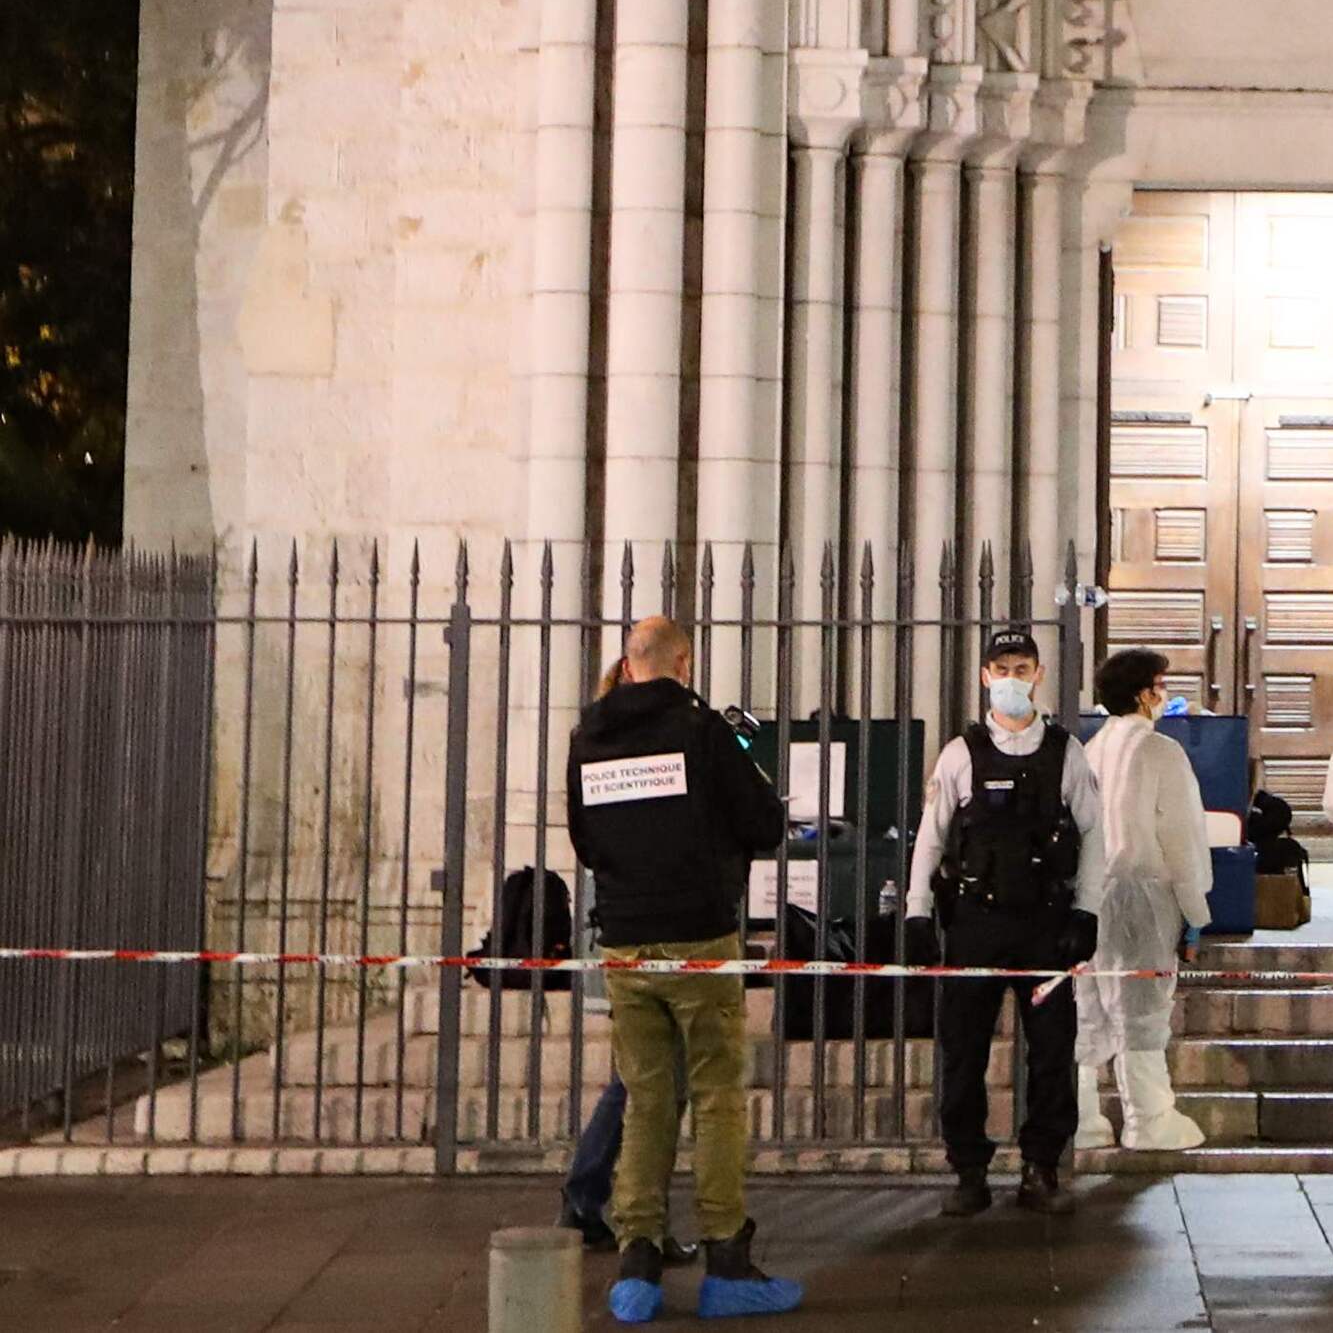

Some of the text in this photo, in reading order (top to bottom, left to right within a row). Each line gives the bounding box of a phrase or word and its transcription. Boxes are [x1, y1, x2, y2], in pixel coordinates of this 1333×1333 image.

[583, 763, 682, 781] POLICE TECHNIQUE
[590, 776, 676, 794] ET SCIENTIFIQUE
